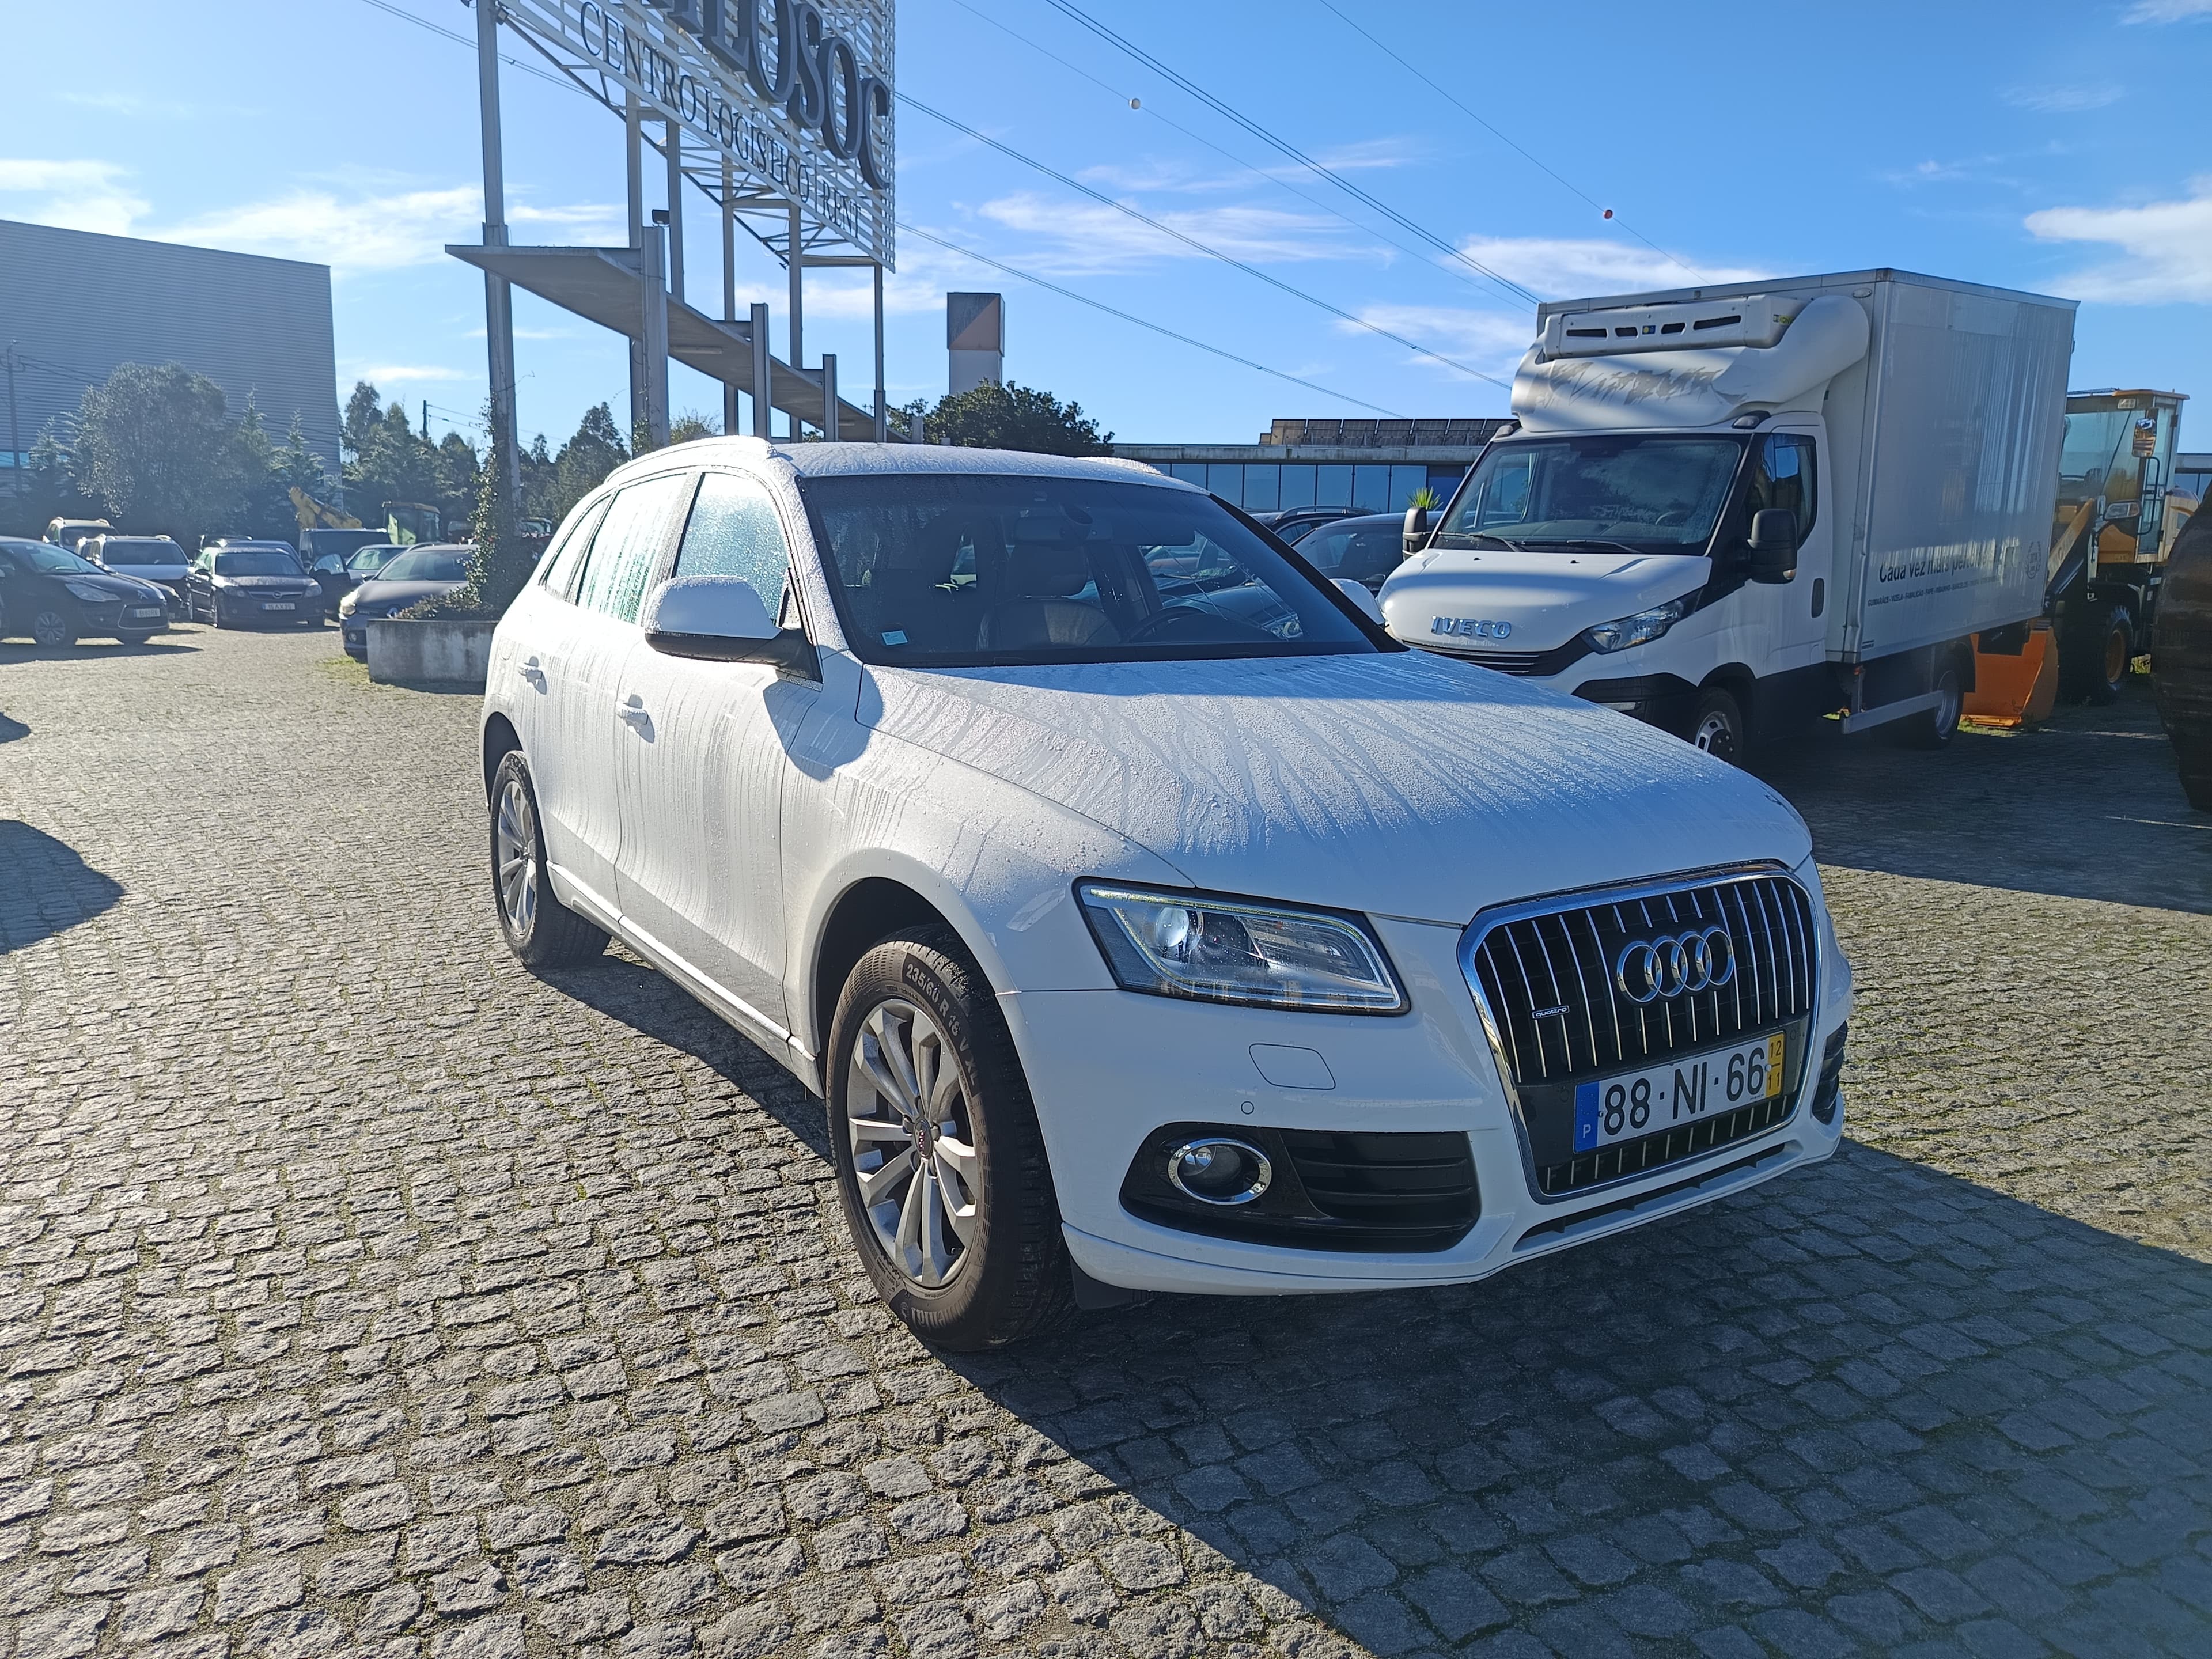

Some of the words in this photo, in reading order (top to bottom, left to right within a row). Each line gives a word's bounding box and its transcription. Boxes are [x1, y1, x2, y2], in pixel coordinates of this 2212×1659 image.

[580, 1, 696, 122] CENTRO
[821, 179, 861, 239] RENT
[1909, 560, 1926, 578] vez
[1431, 616, 1512, 639] IVECO
[906, 963, 940, 1003] 235/60
[939, 998, 949, 1017] R
[1536, 1007, 1567, 1017] quattro
[1770, 1040, 1782, 1058] 12
[1767, 1071, 1781, 1090] 11
[1582, 1124, 1591, 1139] P
